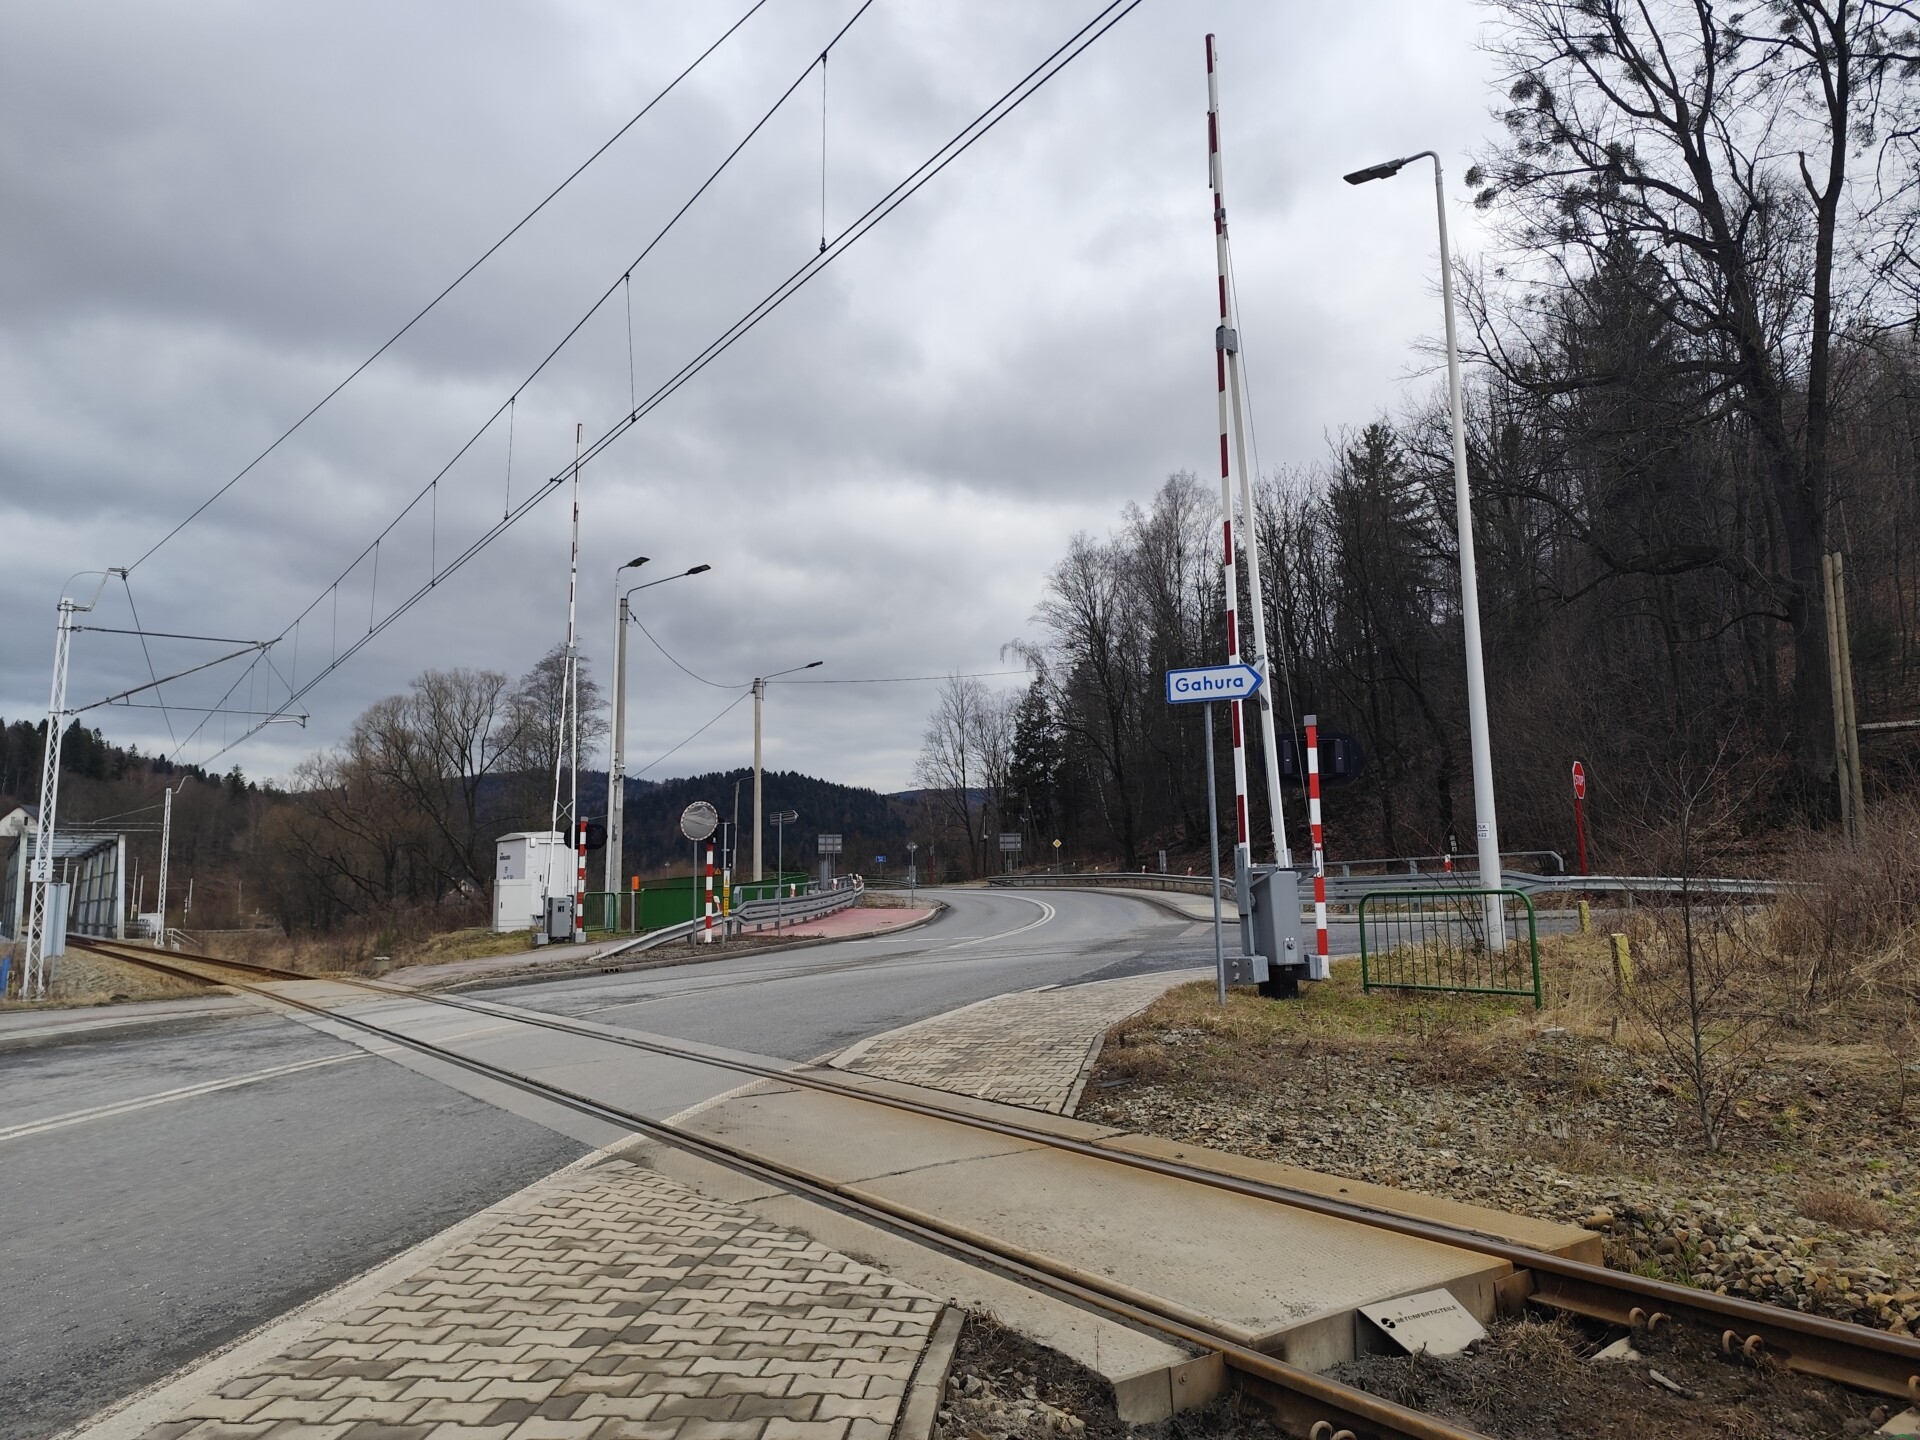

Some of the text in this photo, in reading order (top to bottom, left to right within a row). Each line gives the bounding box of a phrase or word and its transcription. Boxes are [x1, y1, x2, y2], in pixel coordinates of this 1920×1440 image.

[1175, 675, 1244, 692] Gahura
[1574, 774, 1584, 785] STOP
[37, 861, 48, 871] 12
[38, 872, 45, 880] 4
[557, 905, 565, 913] N1
[1394, 1304, 1458, 1324] BETONFERTIGTEILE
